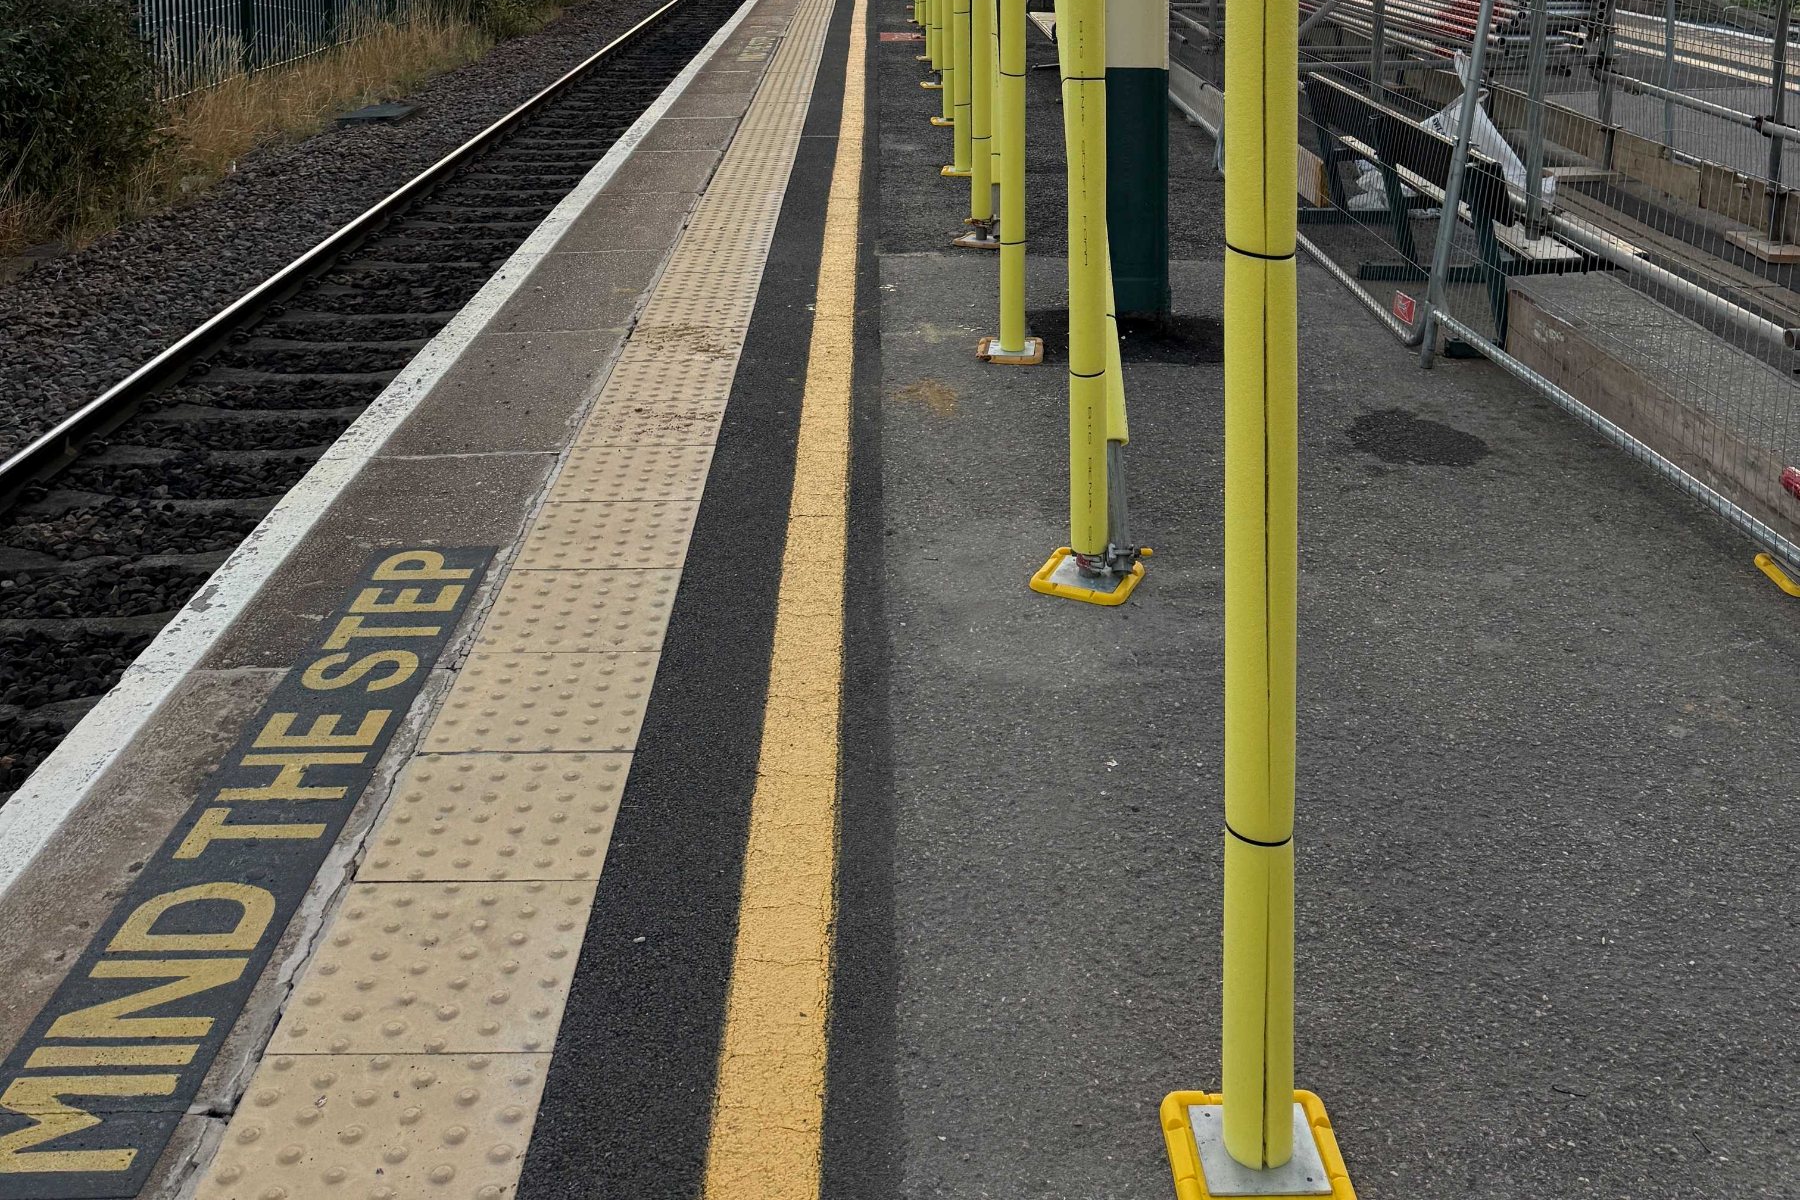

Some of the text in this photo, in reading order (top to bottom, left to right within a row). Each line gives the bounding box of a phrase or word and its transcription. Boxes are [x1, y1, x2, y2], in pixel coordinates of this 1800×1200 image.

[0, 550, 475, 1173] MIND THE STEP
